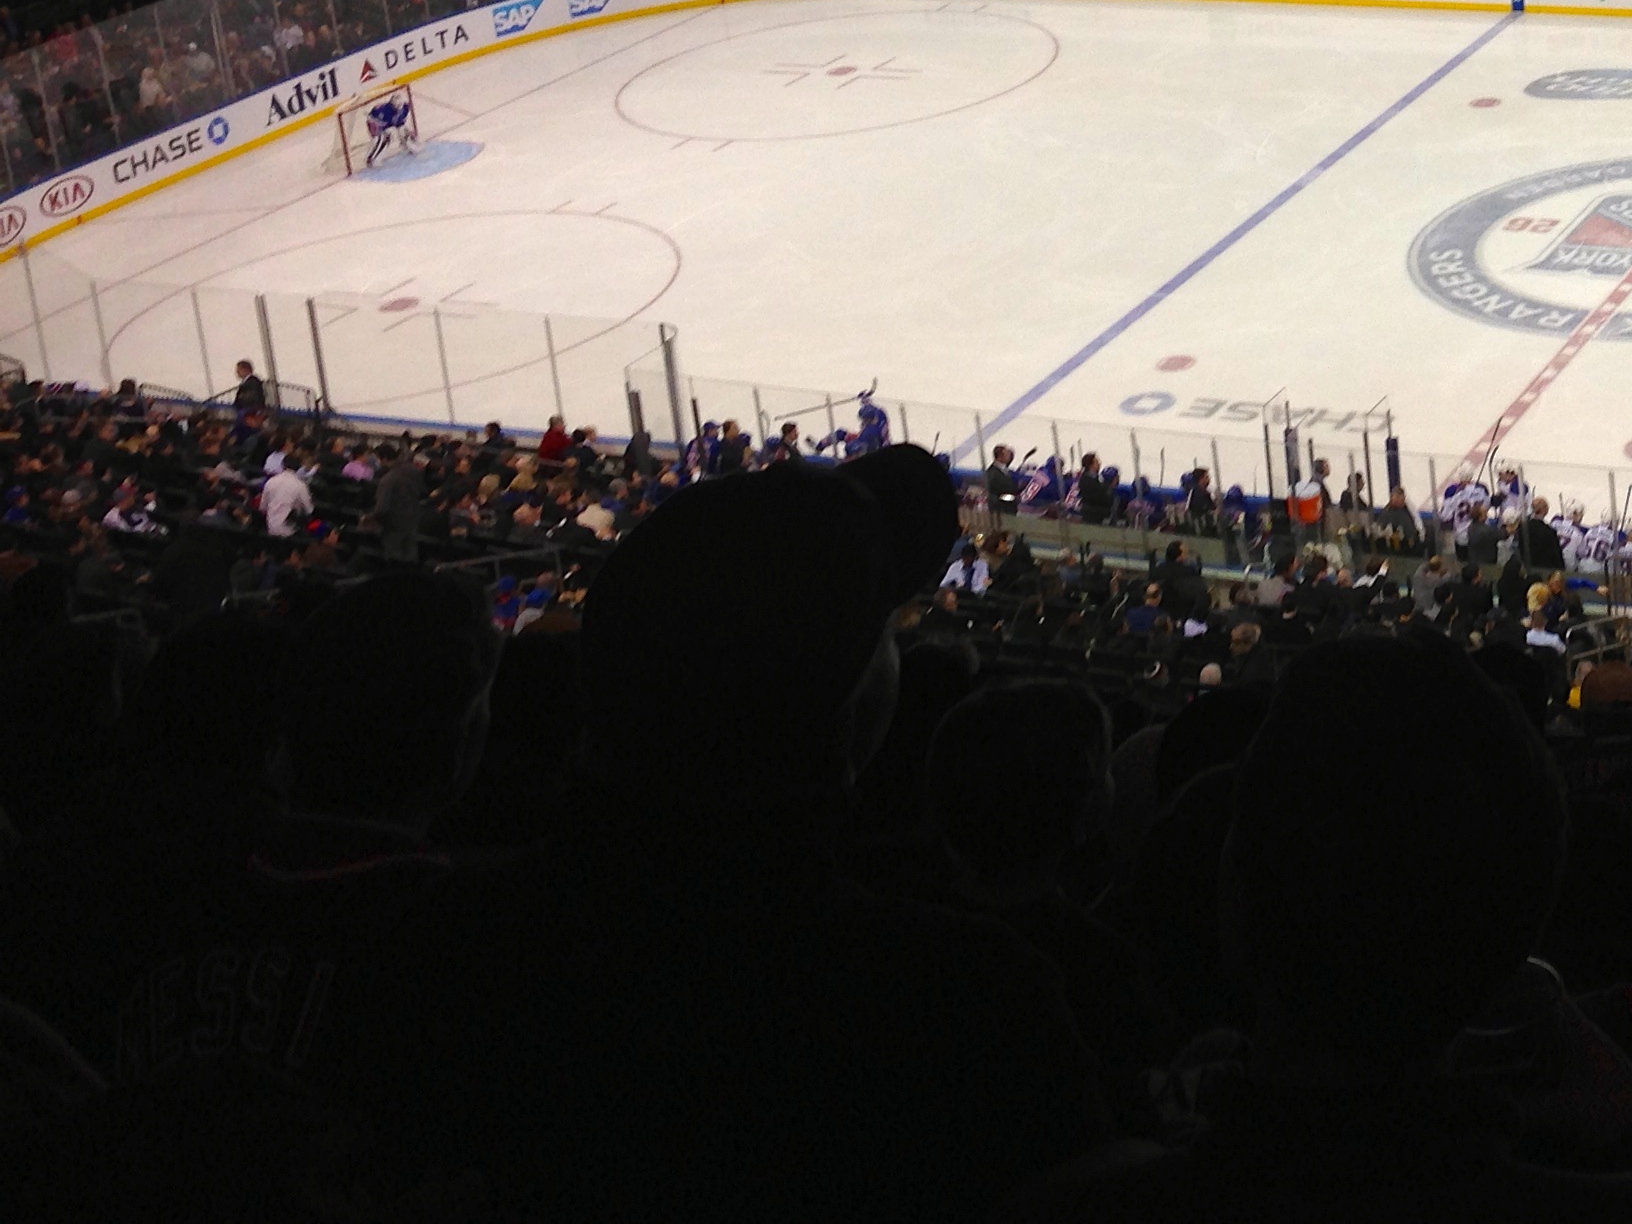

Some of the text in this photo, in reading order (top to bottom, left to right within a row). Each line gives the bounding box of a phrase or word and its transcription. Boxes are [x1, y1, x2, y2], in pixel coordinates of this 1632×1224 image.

[494, 3, 535, 32] SAP
[385, 24, 470, 70] DELTA
[265, 68, 340, 127] Advil
[113, 127, 203, 183] CHASE
[50, 182, 86, 213] KIA
[1427, 248, 1575, 331] RANGERS
